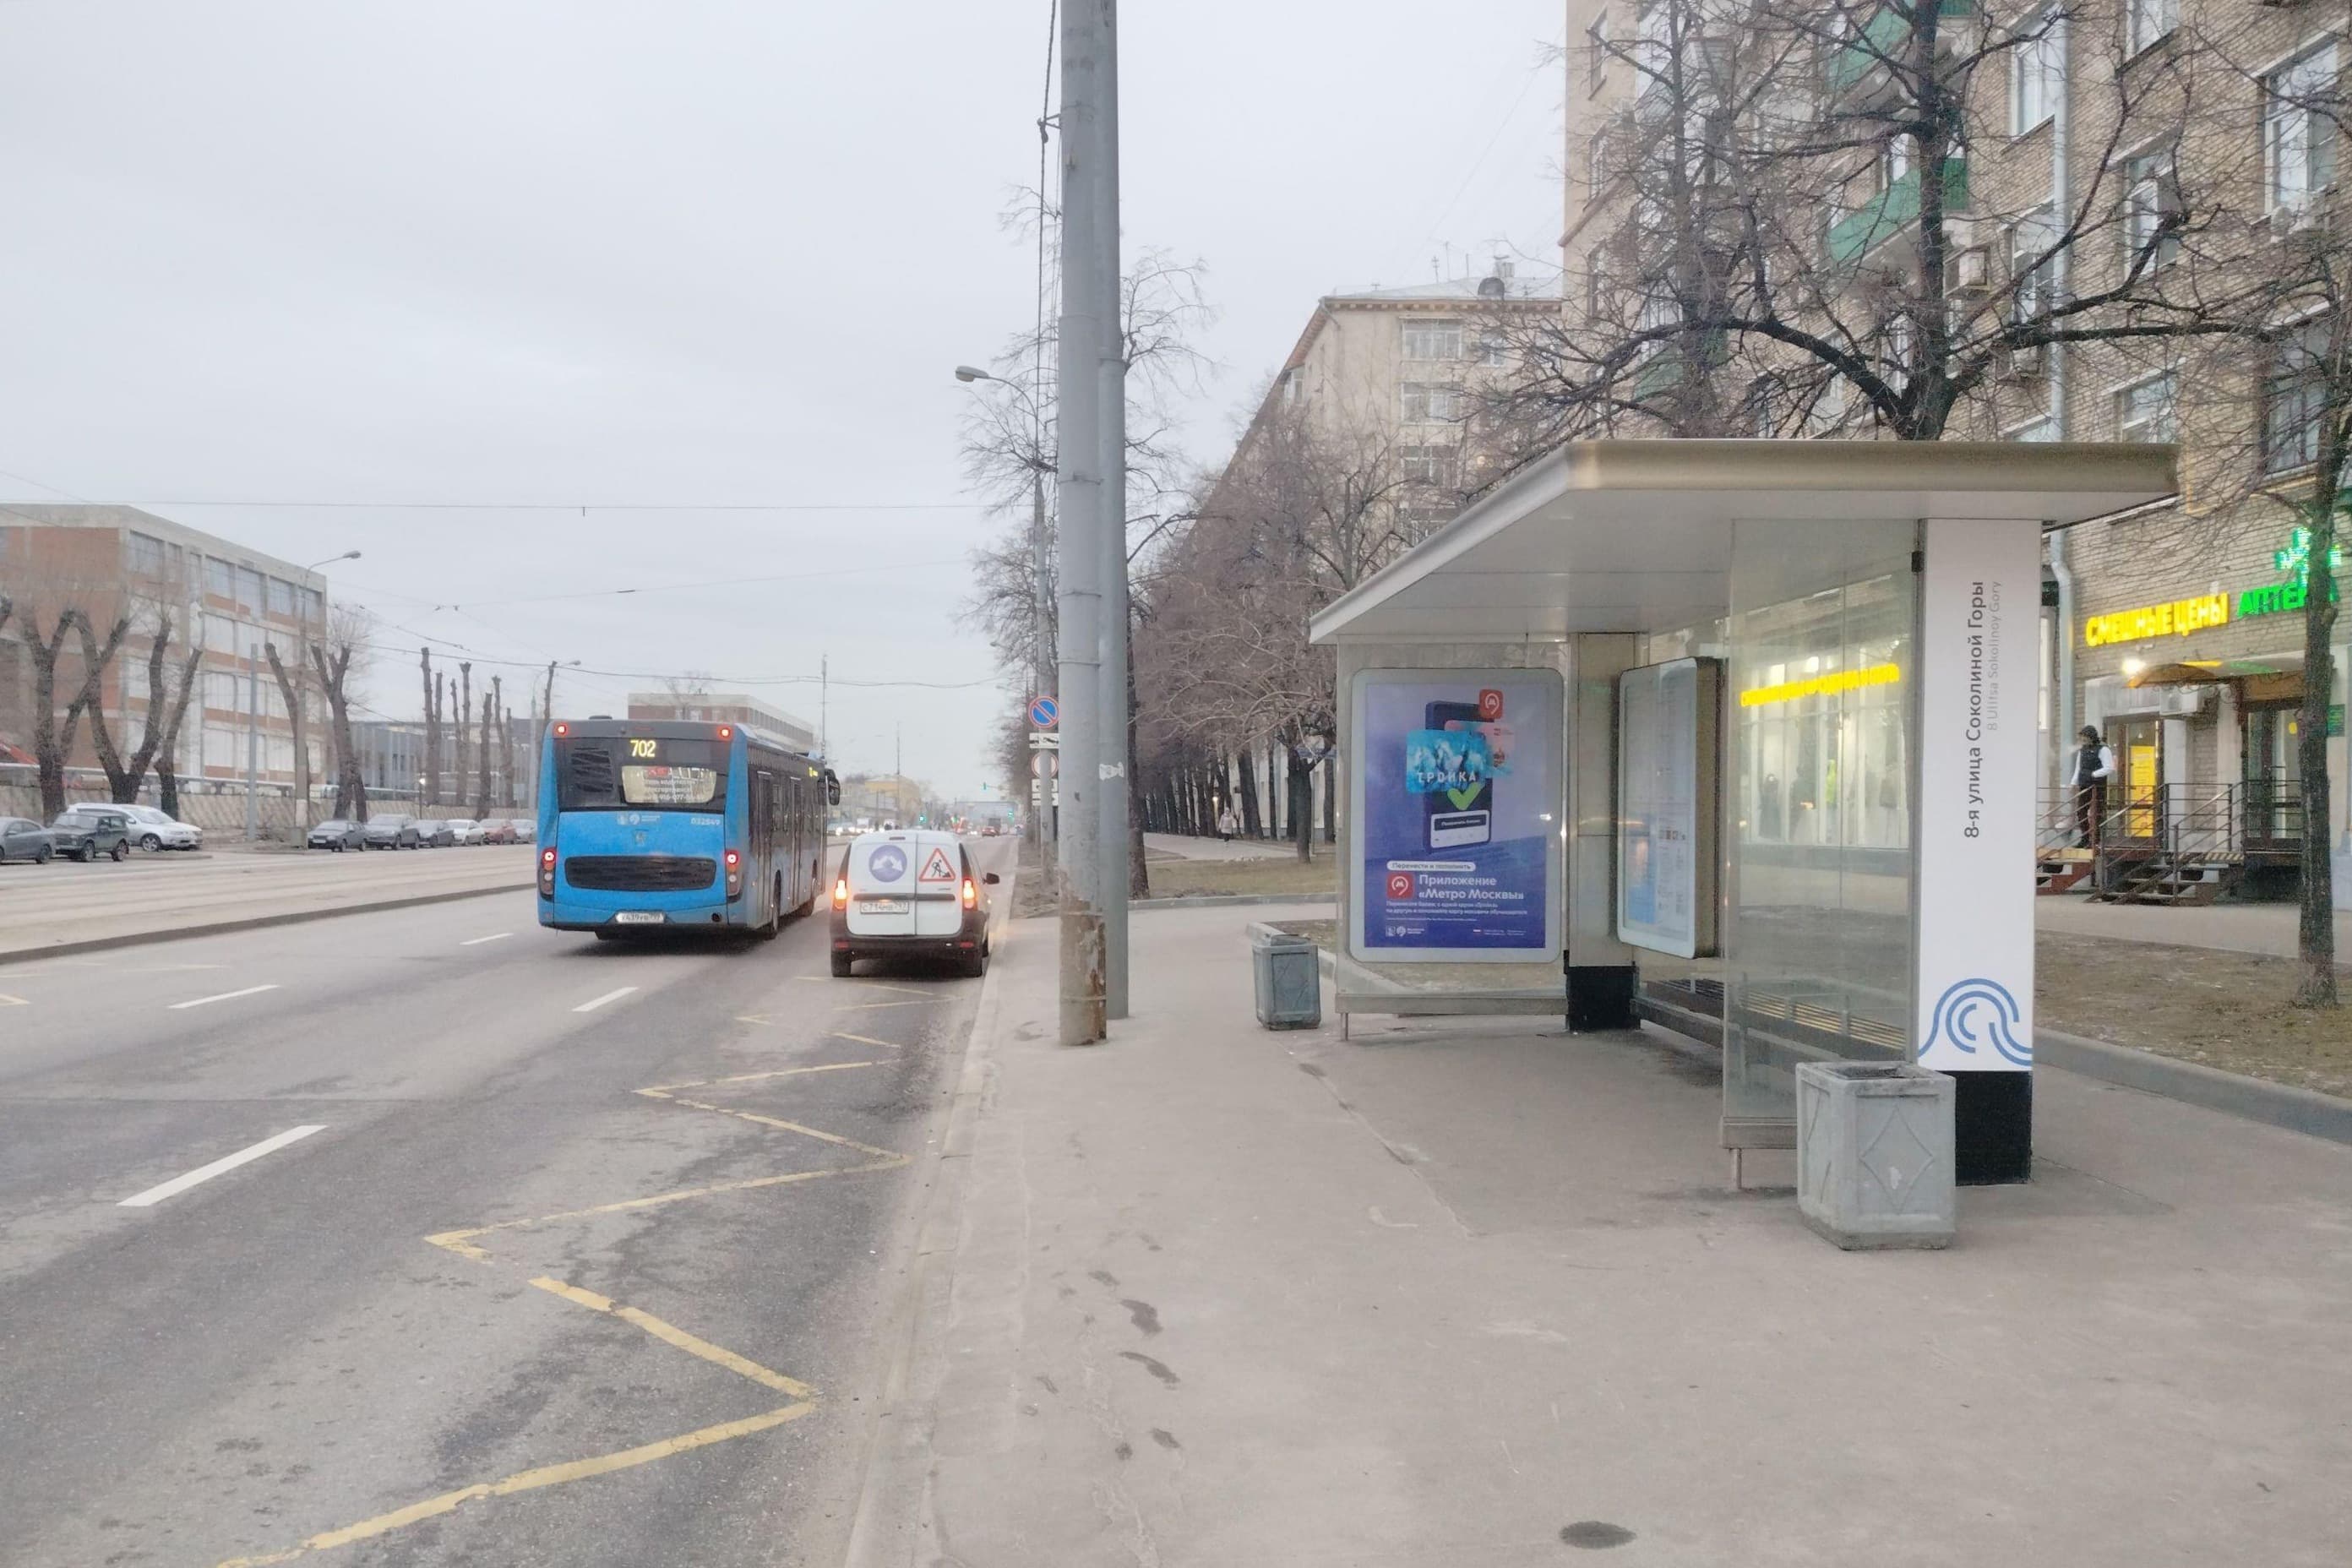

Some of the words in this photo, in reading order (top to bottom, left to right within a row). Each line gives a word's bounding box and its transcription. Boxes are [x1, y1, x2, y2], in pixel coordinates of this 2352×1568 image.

[1968, 581, 1986, 629] Горы
[1989, 580, 2001, 612] Gory
[2236, 577, 2340, 620] АПТЕ
[2085, 602, 2172, 647] СМЕШНЫЕ
[2173, 591, 2230, 637] ЦЕНЫ
[1988, 615, 2001, 678] Sokolinoy
[1966, 634, 1983, 742] Соколиной
[629, 740, 656, 757] 702
[1968, 747, 1984, 804] улица
[1964, 809, 1979, 839] 8-я
[1418, 874, 1497, 886] Приложение
[1418, 888, 1467, 901] «Метро
[1468, 890, 1524, 900] Москвы»
